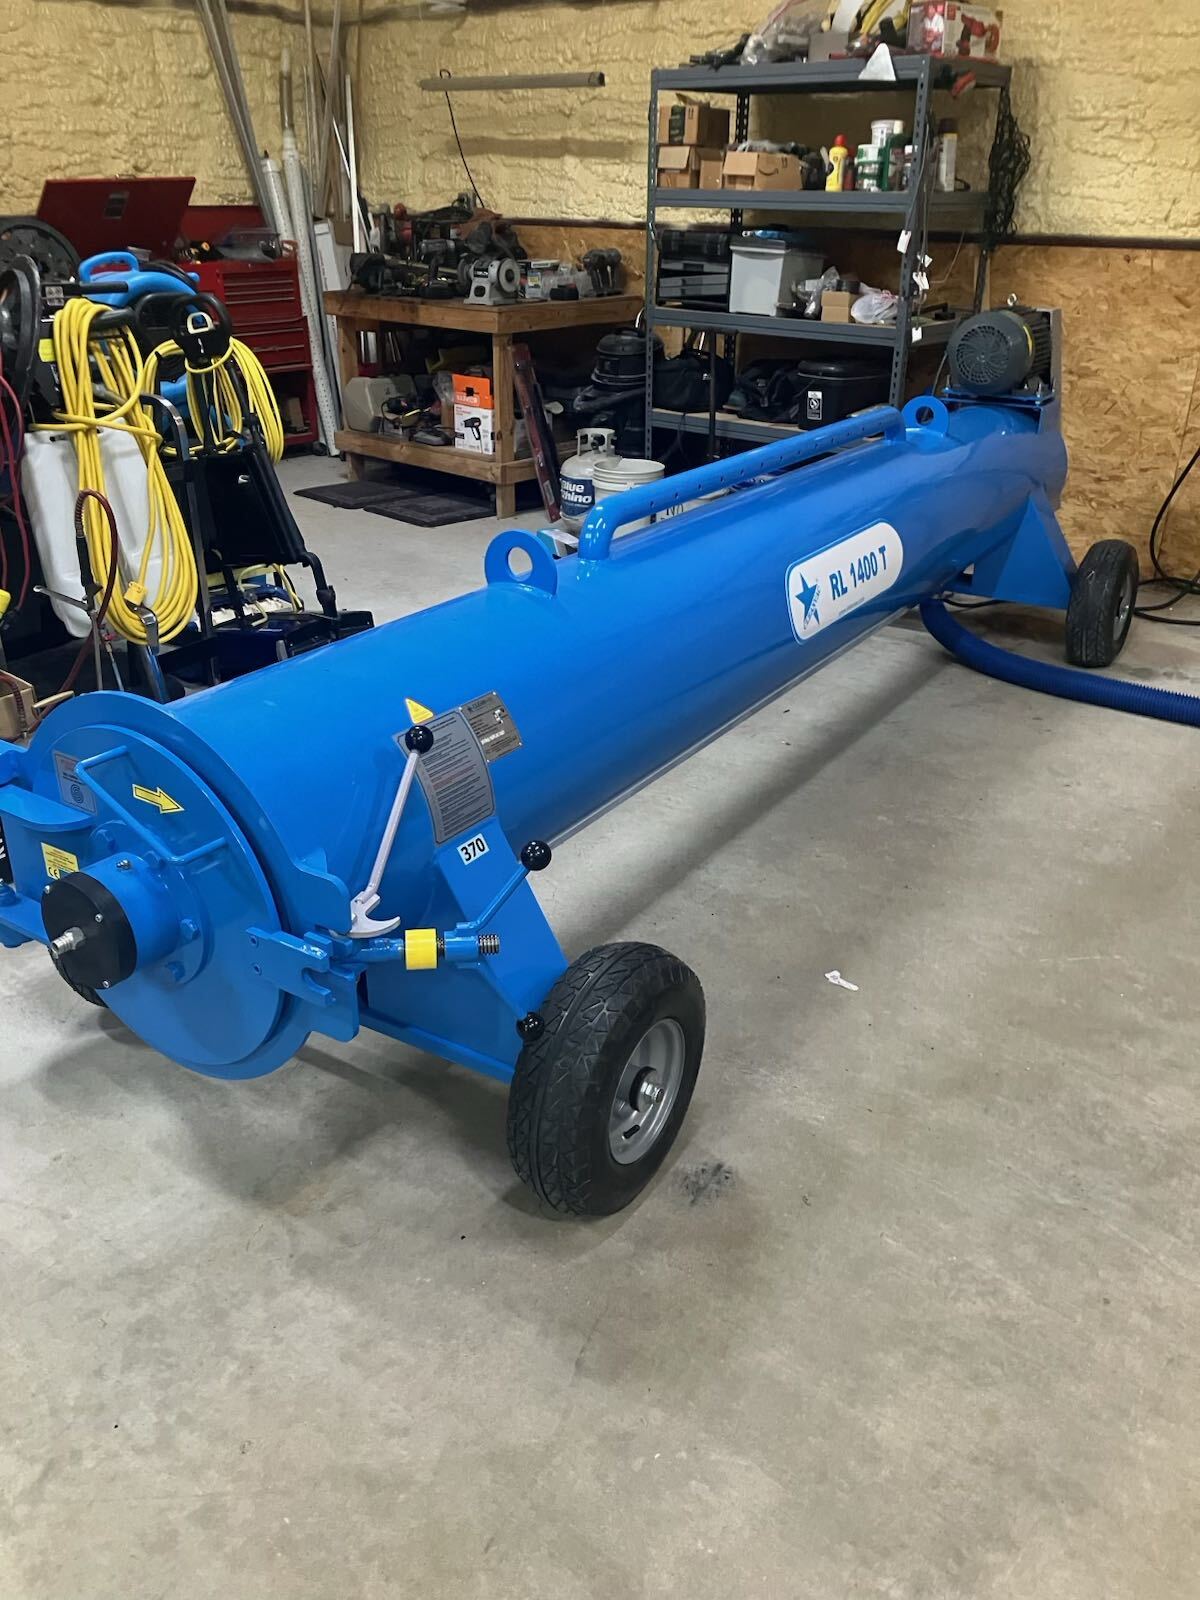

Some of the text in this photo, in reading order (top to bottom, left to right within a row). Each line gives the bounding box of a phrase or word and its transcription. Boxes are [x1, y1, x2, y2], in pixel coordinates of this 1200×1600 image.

[829, 545, 886, 600] RL 1400 T
[461, 838, 485, 861] 370
